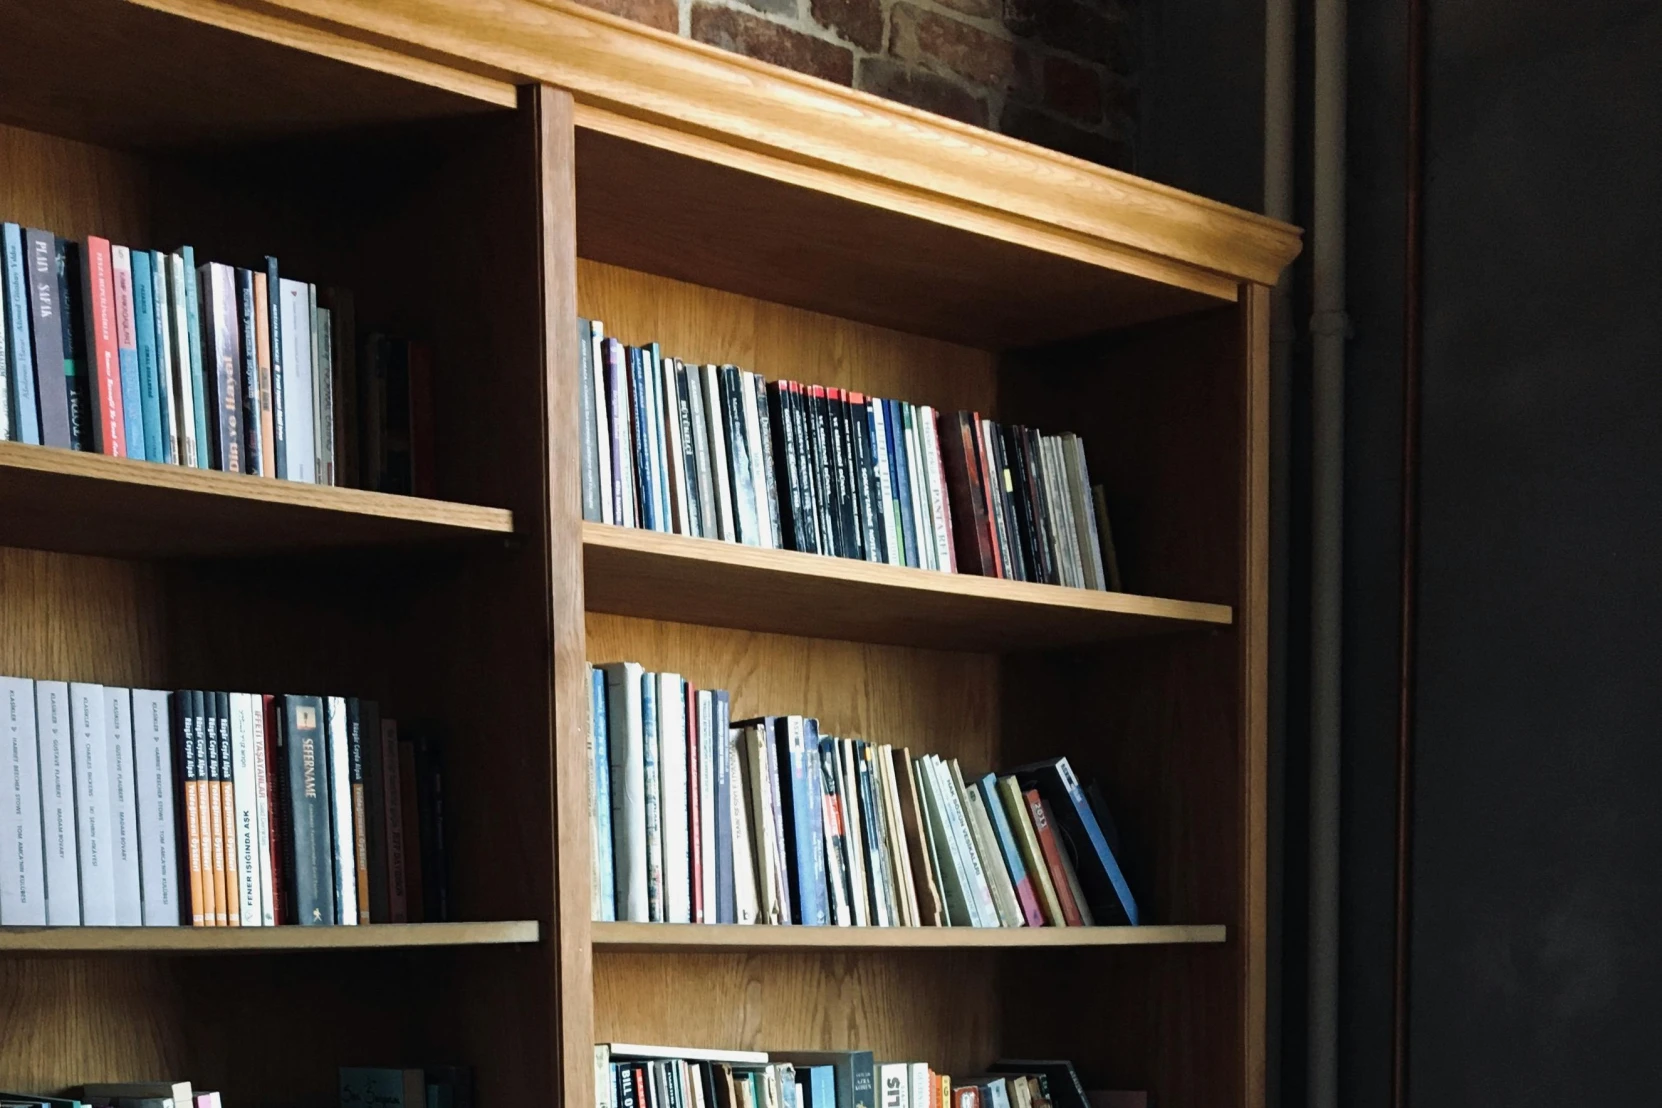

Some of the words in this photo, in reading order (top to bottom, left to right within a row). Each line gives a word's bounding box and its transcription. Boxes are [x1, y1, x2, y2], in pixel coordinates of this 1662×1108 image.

[302, 738, 315, 799] SEFERNAME
[1032, 801, 1047, 828] 2011
[243, 832, 251, 873] IŞIĞINDA
[245, 876, 253, 905] FENER
[621, 1069, 632, 1096] BILL
